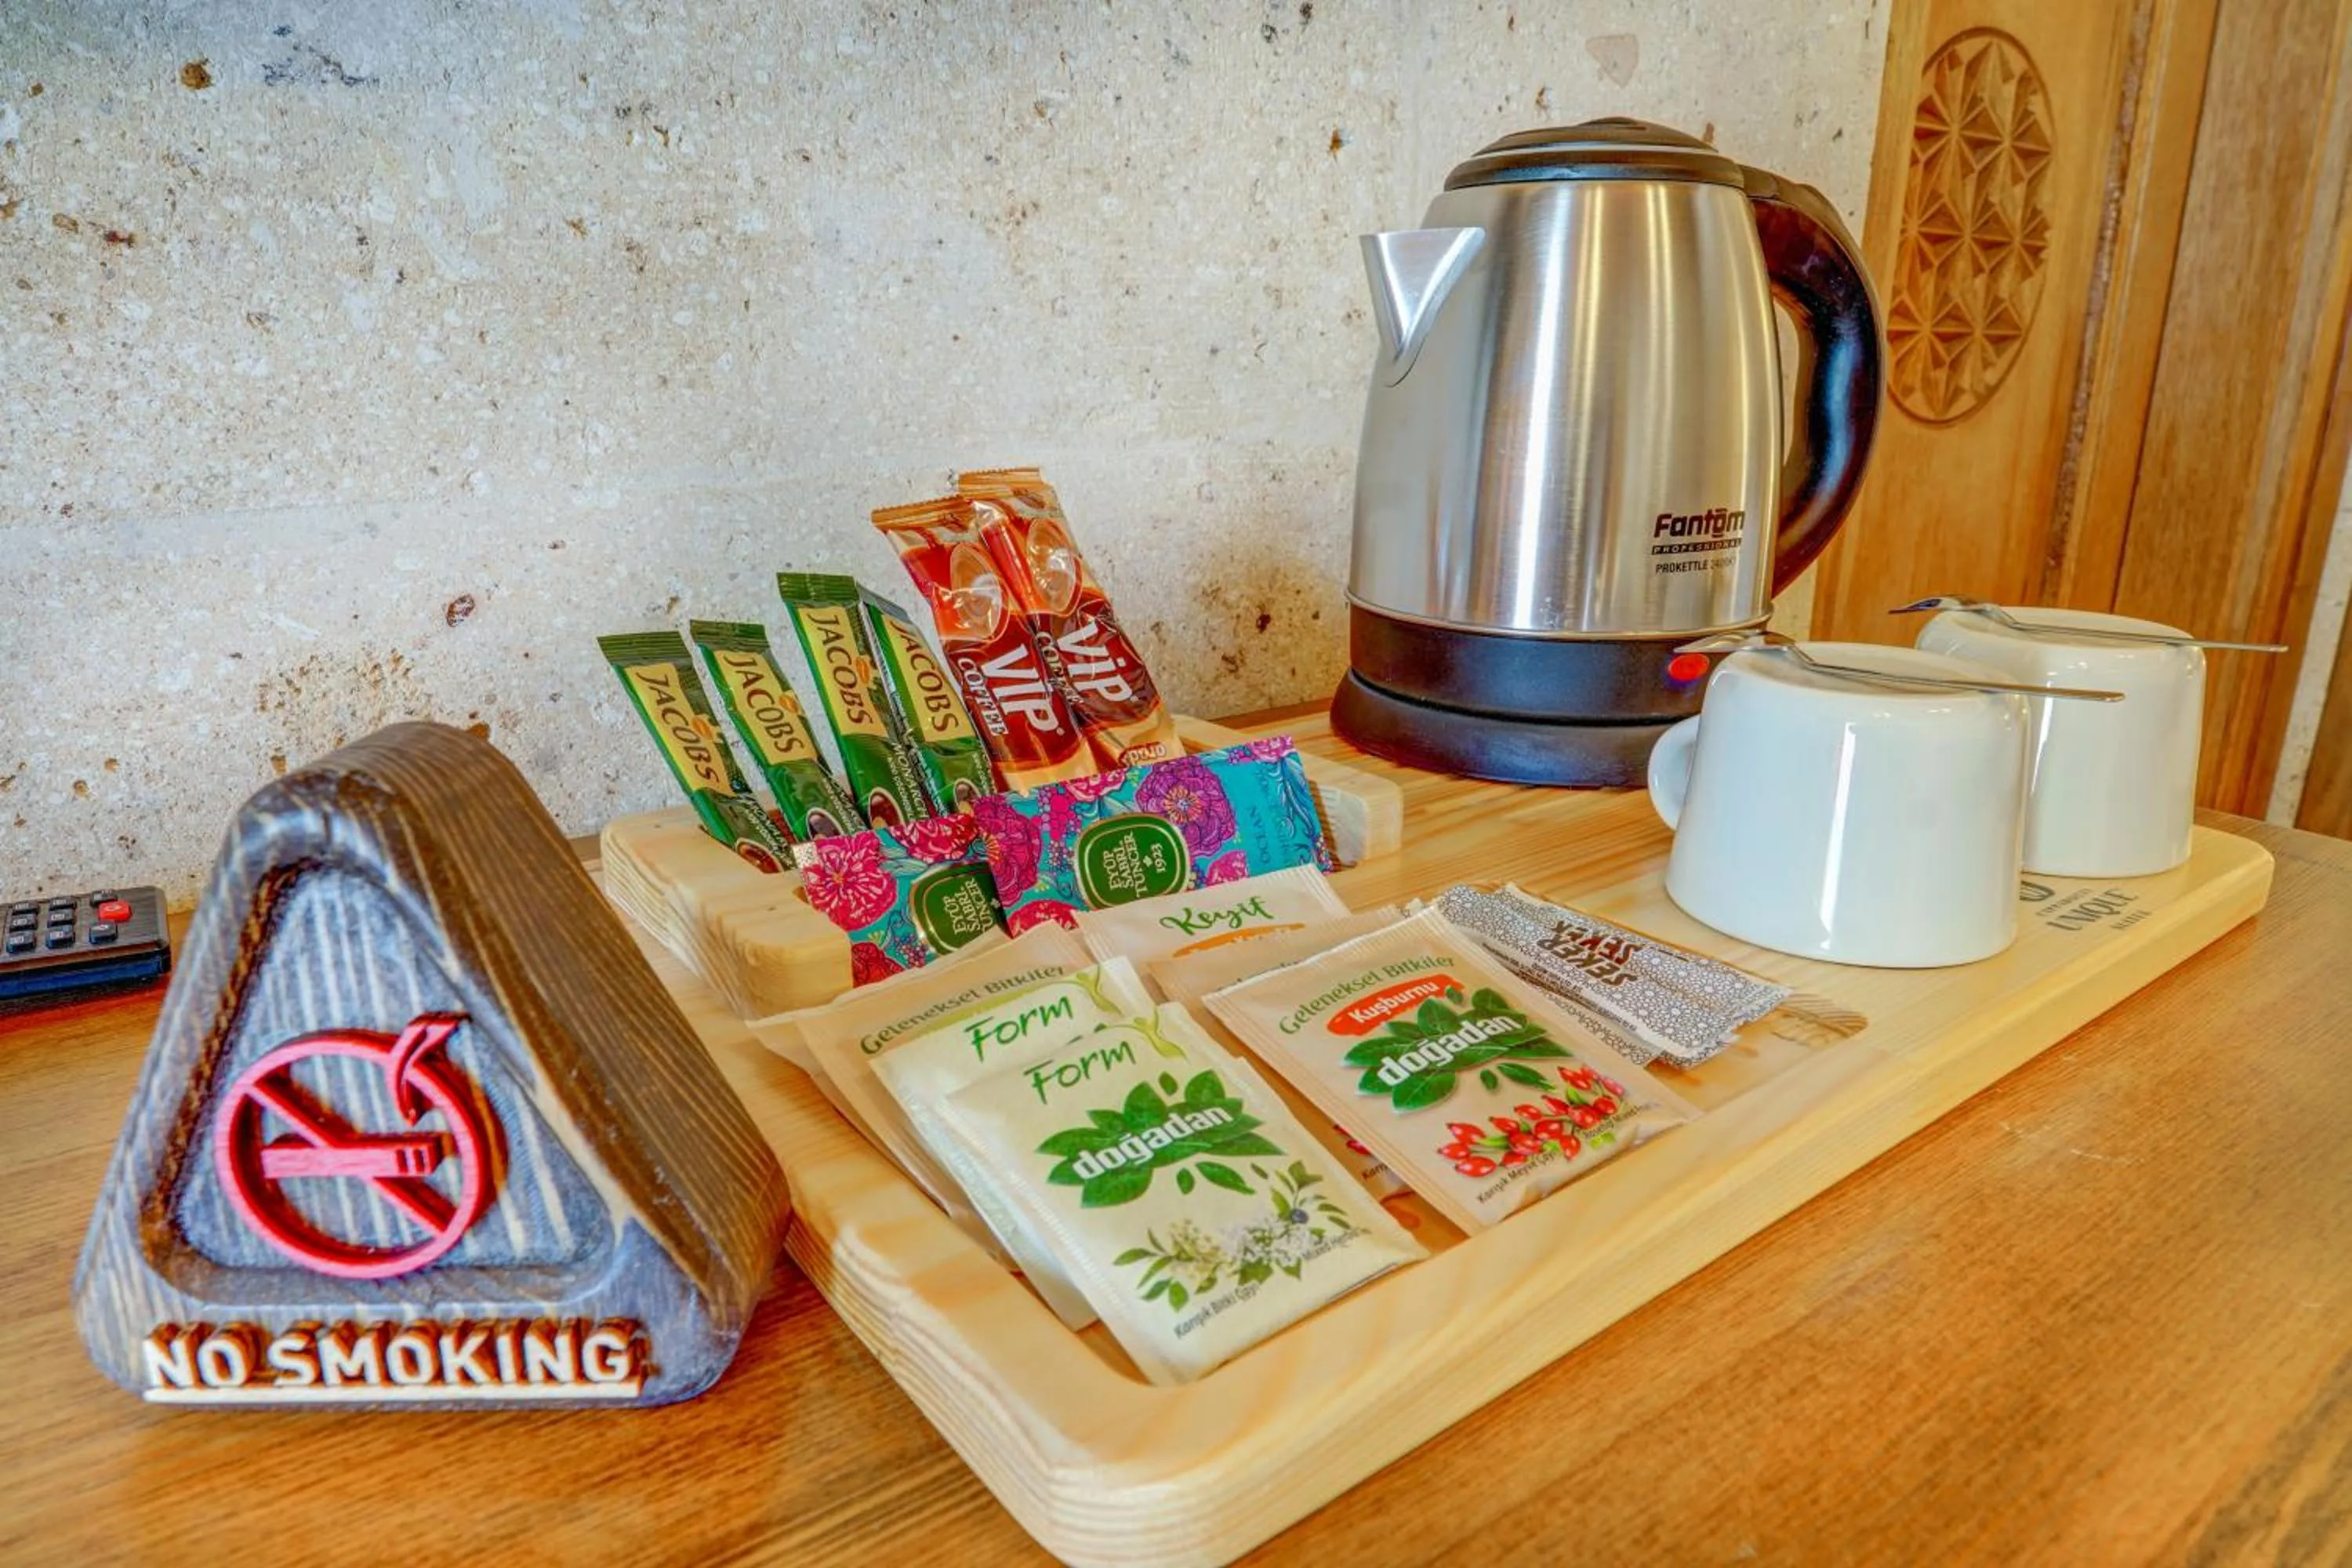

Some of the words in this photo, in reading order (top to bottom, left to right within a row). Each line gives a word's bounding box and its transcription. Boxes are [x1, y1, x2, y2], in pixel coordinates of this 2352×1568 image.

[722, 654, 804, 753] JACOBS
[806, 613, 873, 726] JACOBS
[890, 620, 960, 734] JACOBS
[636, 672, 720, 784] JACOBS
[964, 994, 1074, 1062] Form
[1278, 971, 1381, 1035] Geleneksel
[1381, 955, 1455, 983] Bitkiler
[1347, 980, 1441, 1023] Kuşburnu
[1023, 1040, 1138, 1105] Form
[1377, 1014, 1523, 1087] doğadan
[1071, 1106, 1234, 1180] doğadan
[144, 1333, 249, 1388] NO
[267, 1330, 635, 1388] SMOKING
